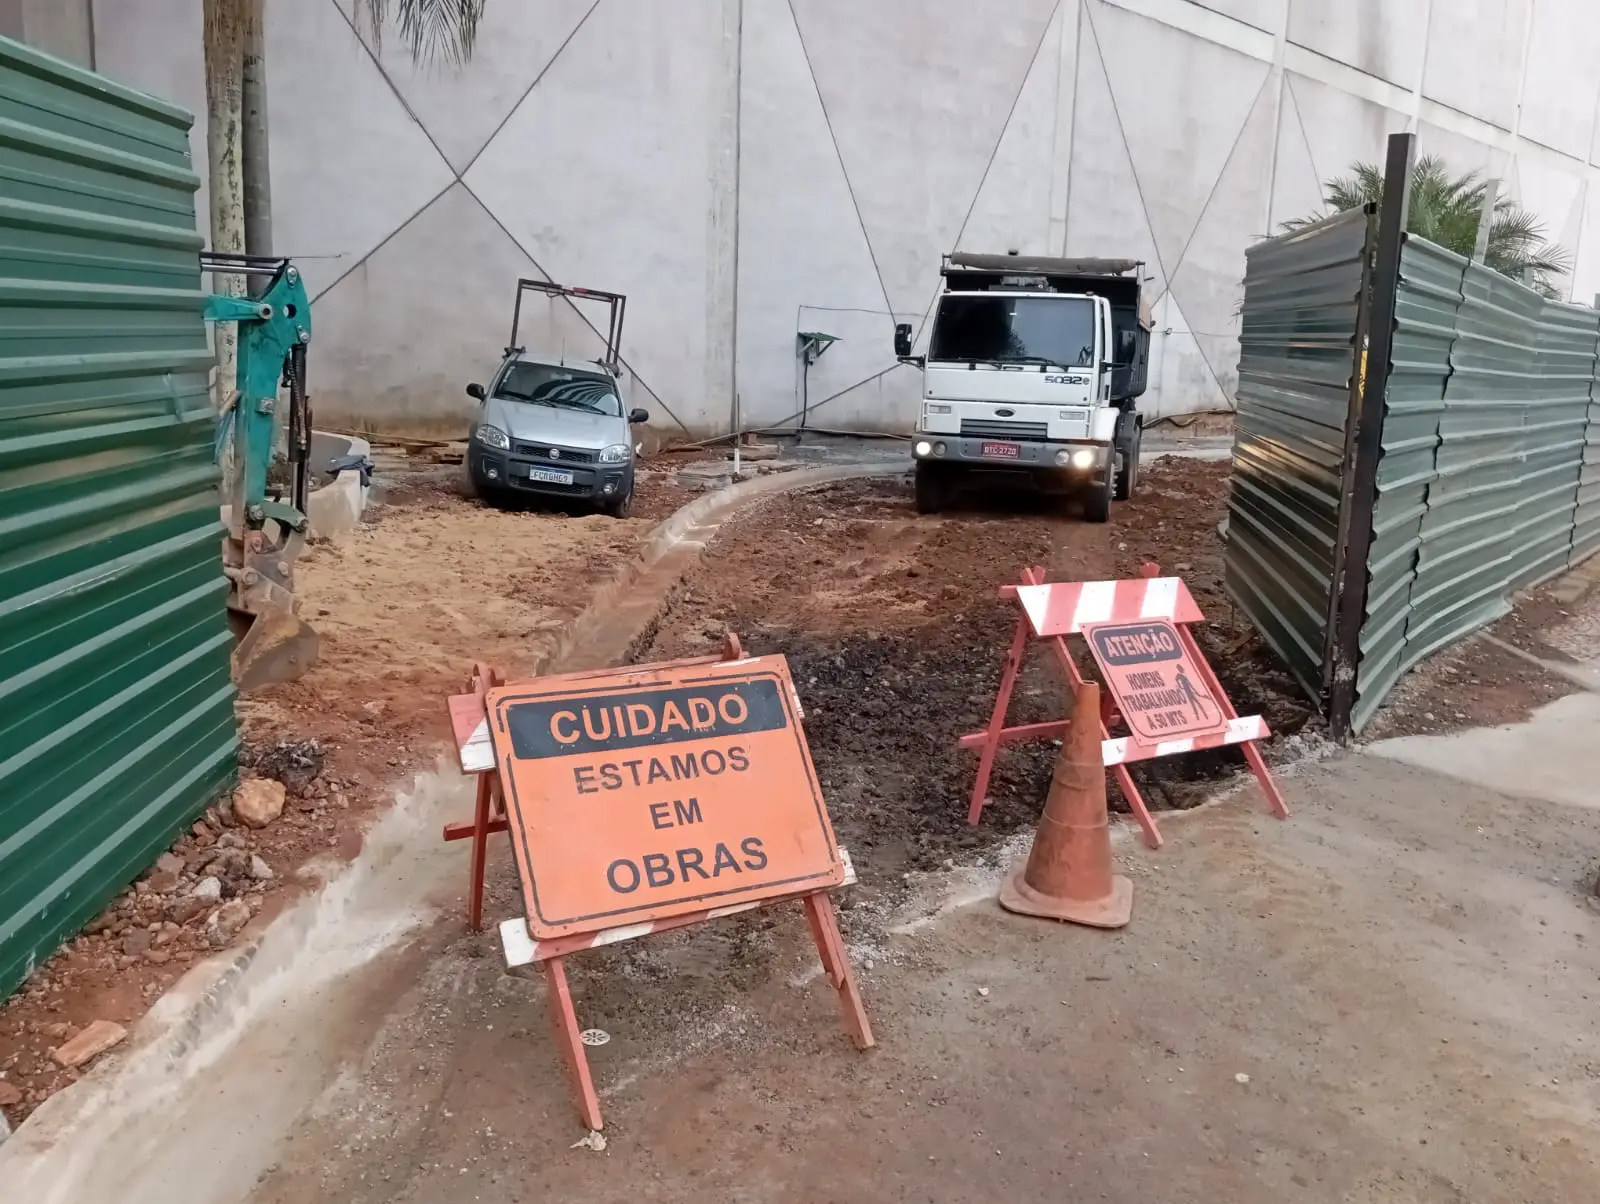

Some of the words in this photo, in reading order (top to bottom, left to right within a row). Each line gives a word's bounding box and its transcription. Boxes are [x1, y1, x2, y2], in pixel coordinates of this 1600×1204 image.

[1103, 628, 1176, 659] ATENÇÃO
[1125, 670, 1165, 690] HOMENS
[1122, 688, 1187, 712] TRABALHANDO
[550, 693, 749, 744] CUIDADO
[1164, 710, 1188, 727] MTS
[573, 746, 750, 794] ESTAMOS
[649, 797, 703, 830] EM
[606, 837, 768, 894] OBRAS
